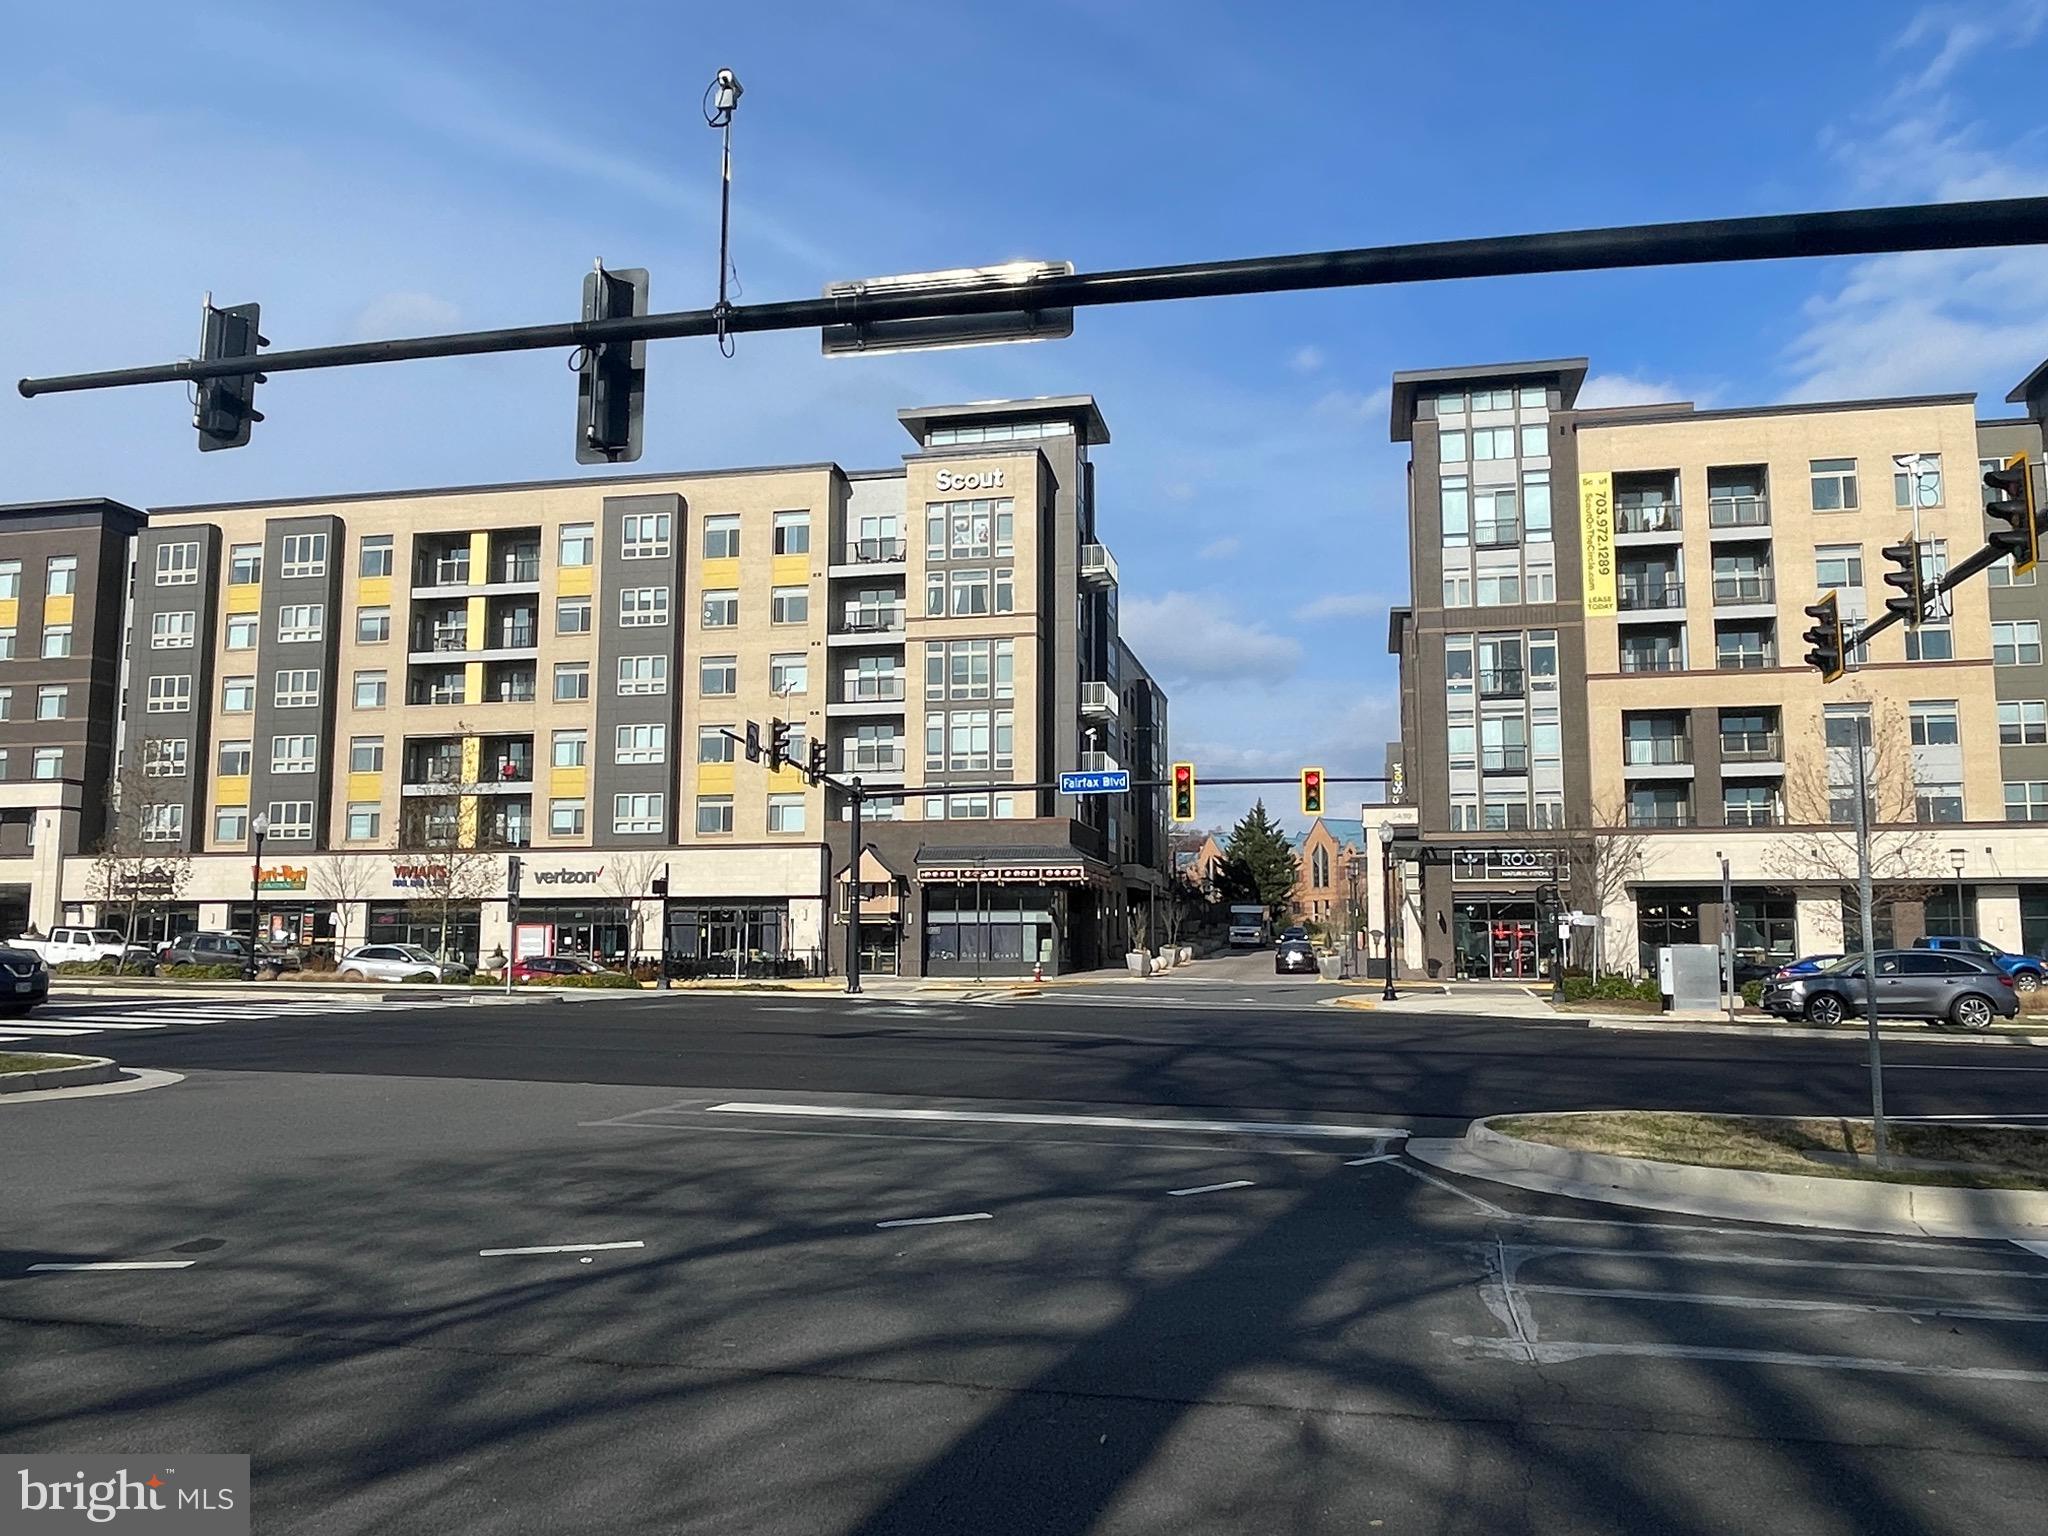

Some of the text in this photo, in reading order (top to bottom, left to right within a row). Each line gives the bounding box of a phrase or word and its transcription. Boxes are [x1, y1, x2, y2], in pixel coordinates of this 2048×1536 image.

[936, 468, 1004, 491] Scout
[1585, 493, 1595, 591] ScoutOnTheCircle.com
[1595, 491, 1610, 576] 703.972.1289
[1063, 775, 1126, 789] Fairfax Blvd
[1392, 762, 1403, 794] Scout
[1501, 853, 1554, 866] ROOTS
[534, 867, 597, 884] verizon
